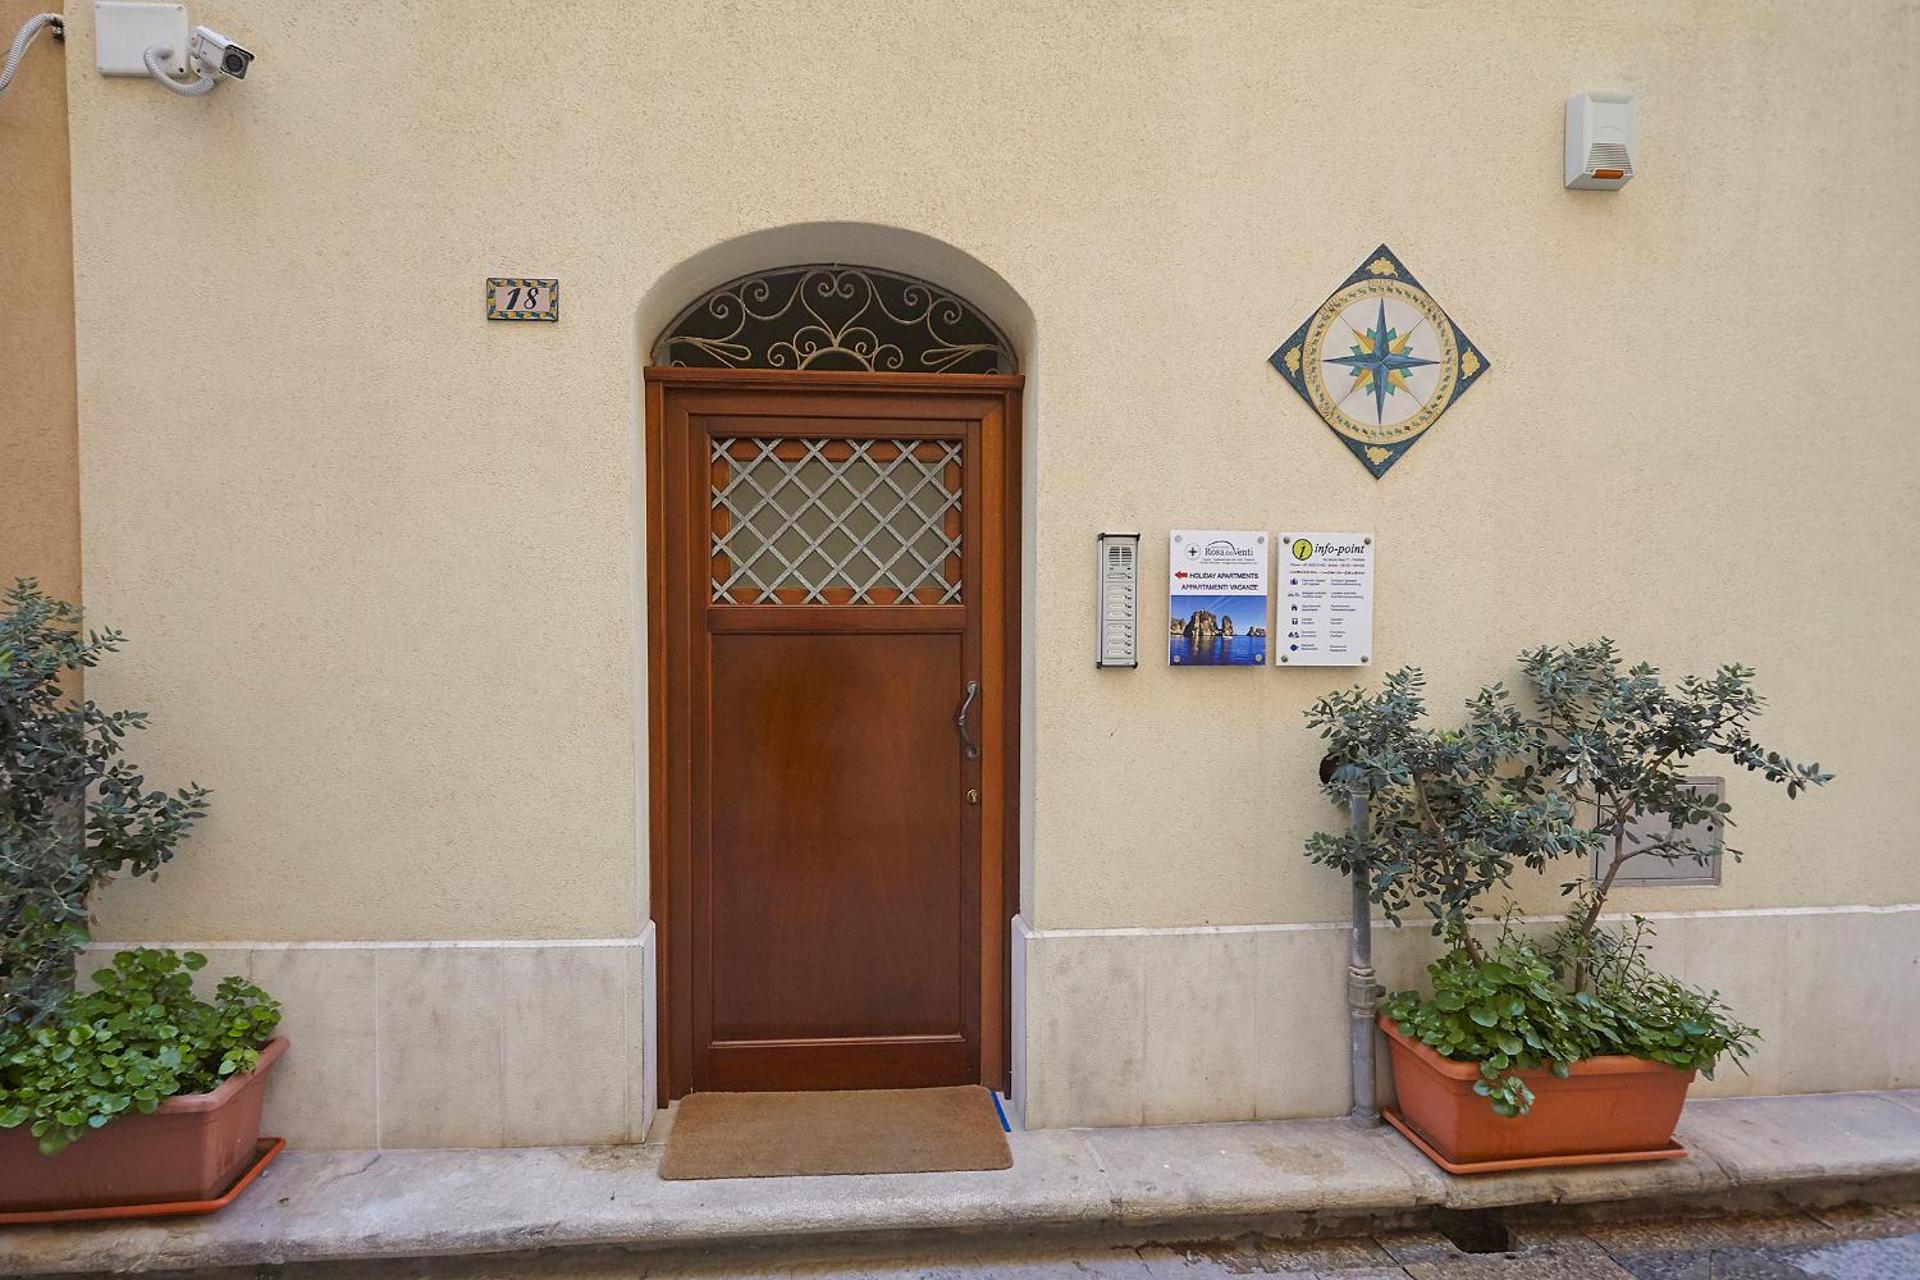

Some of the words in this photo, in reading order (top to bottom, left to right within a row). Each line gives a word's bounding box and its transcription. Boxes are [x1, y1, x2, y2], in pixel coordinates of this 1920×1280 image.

[506, 287, 539, 310] 18
[1205, 548, 1224, 556] Rosa
[1314, 542, 1365, 556] info-point
